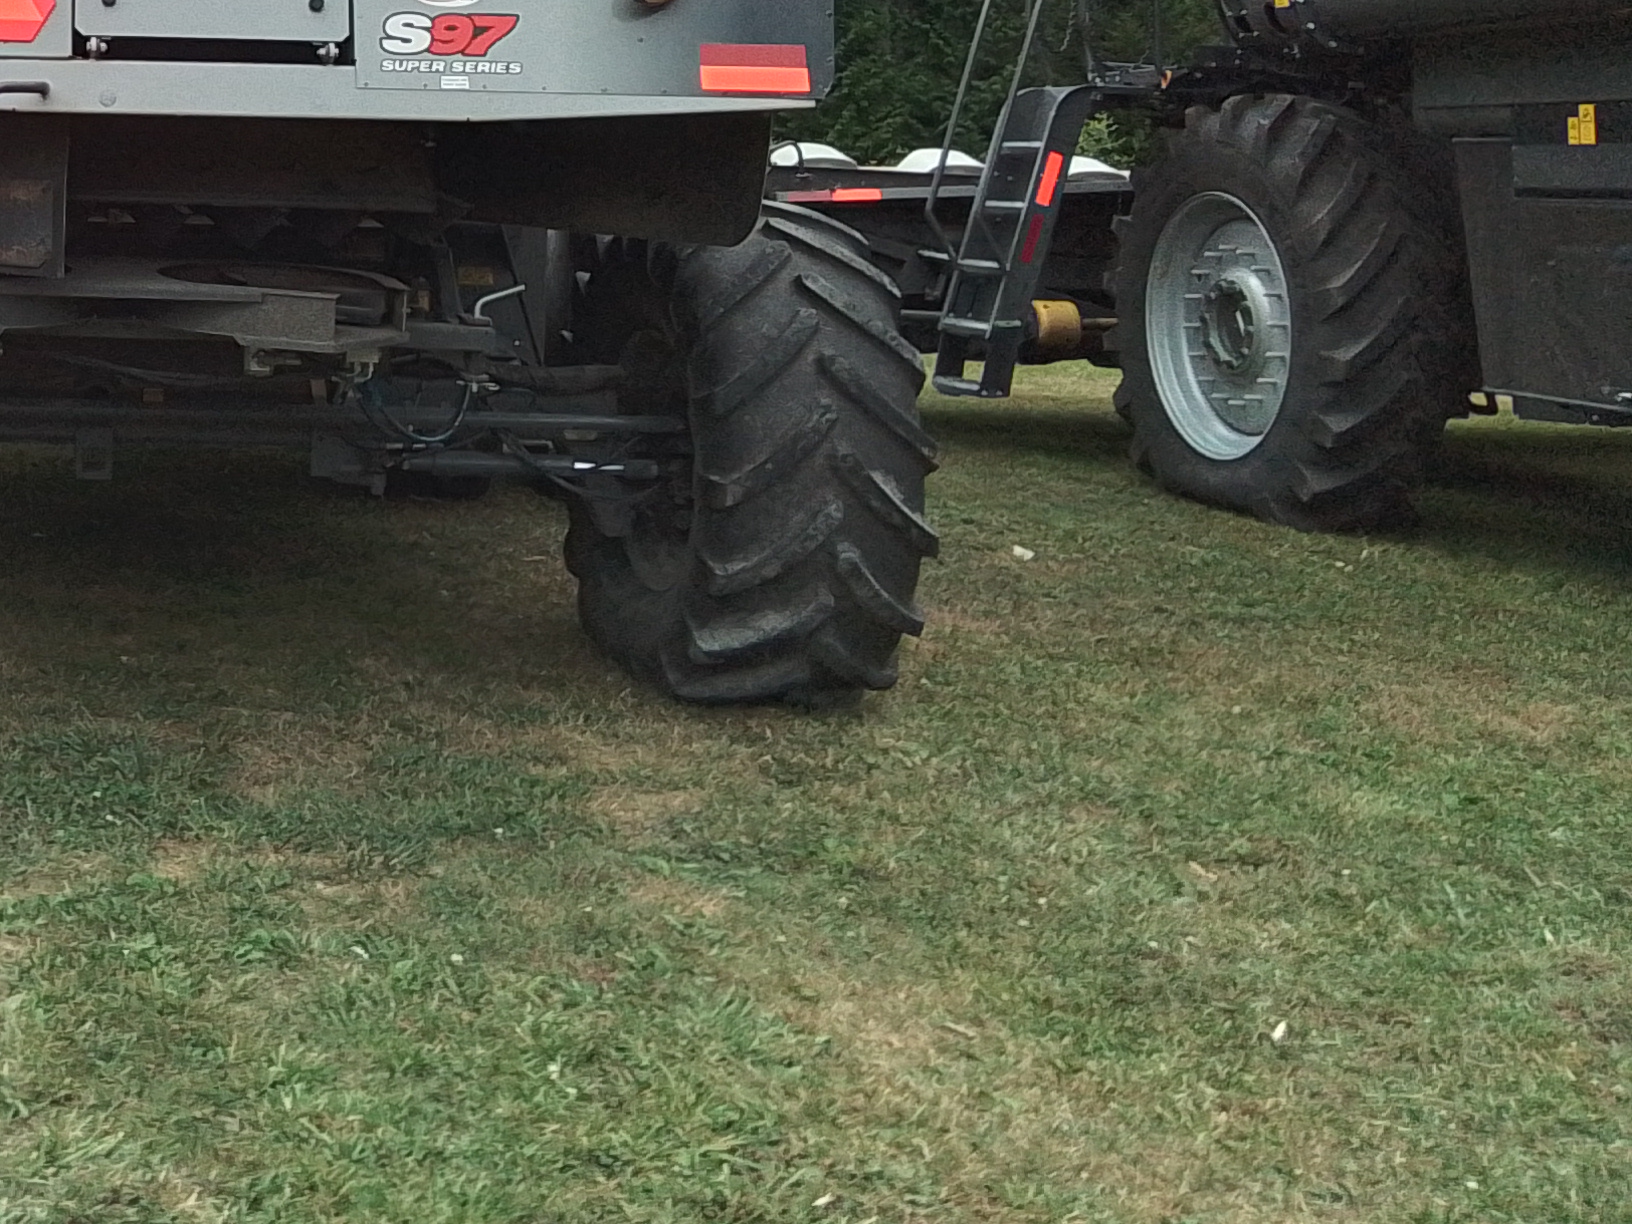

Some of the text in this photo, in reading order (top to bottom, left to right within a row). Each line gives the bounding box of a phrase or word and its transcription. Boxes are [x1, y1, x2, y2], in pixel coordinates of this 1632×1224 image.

[379, 11, 520, 57] S97
[380, 59, 522, 74] SUPER SERIES
